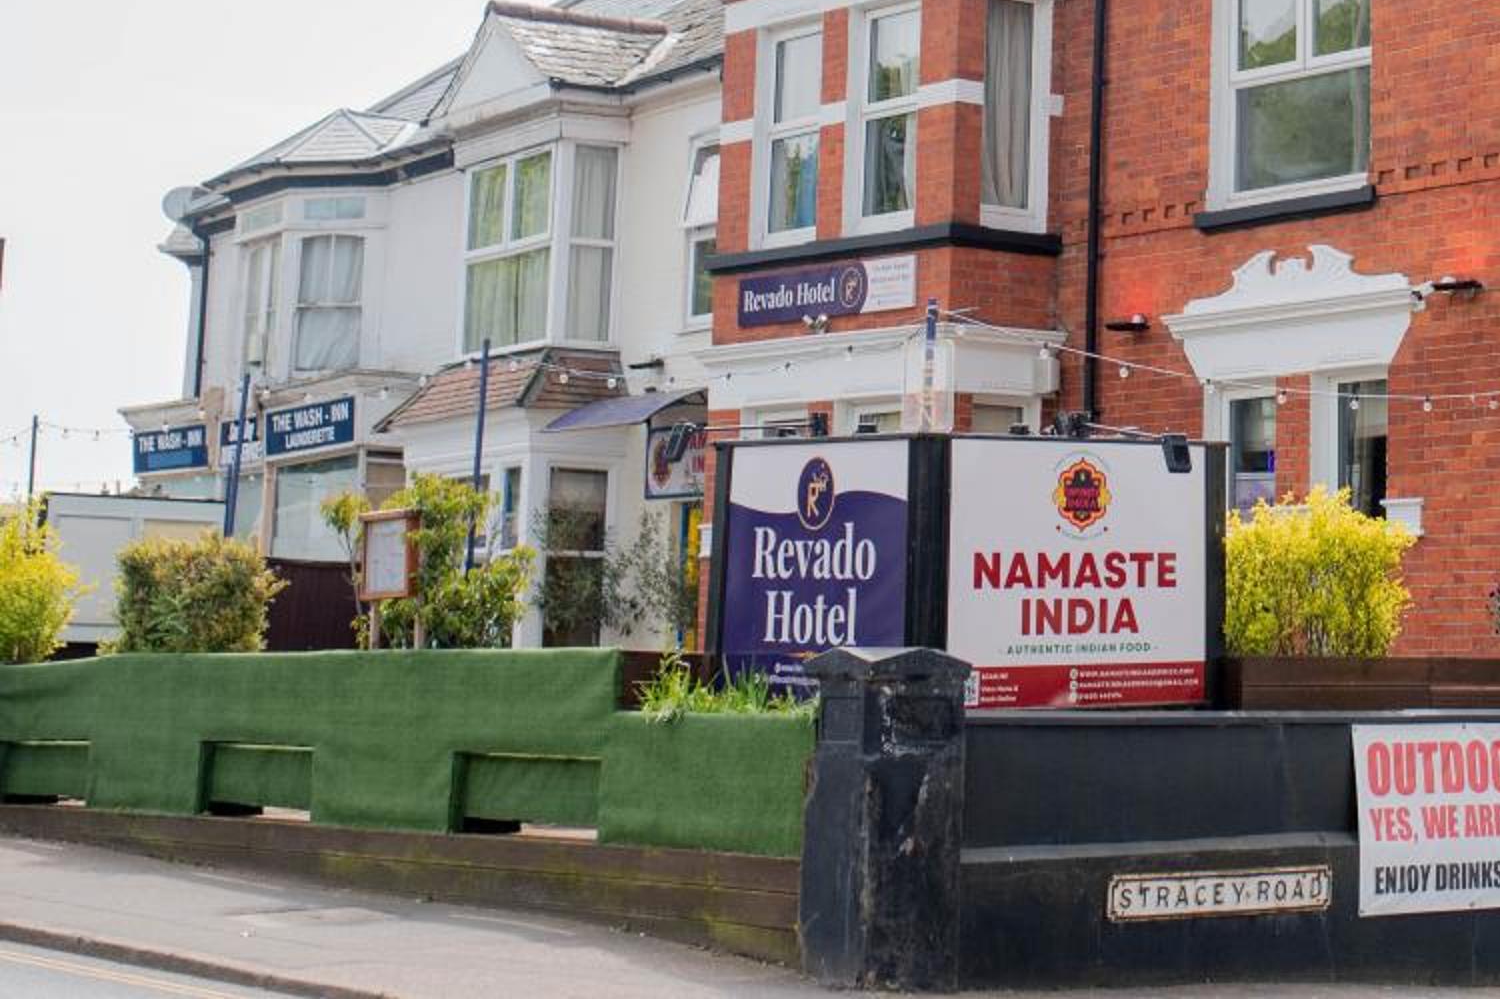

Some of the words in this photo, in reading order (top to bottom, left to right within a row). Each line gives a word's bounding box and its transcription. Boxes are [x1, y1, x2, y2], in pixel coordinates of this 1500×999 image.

[743, 284, 793, 313] Revado
[797, 277, 835, 306] Hotel
[271, 413, 291, 433] THE
[293, 407, 323, 429] WASH
[331, 402, 349, 421] INN
[138, 436, 155, 453] THE
[752, 522, 877, 580] Revado
[973, 552, 1177, 589] NAMASTE
[763, 587, 857, 646] Hotel
[1020, 599, 1139, 635] INDIA
[1007, 644, 1073, 655] AUTHENTIC
[1075, 643, 1117, 653] INDIAN
[1119, 642, 1151, 652] FOOD
[1370, 807, 1419, 843] YES,
[1421, 804, 1460, 840] WE
[1119, 882, 1246, 909] STRACEY
[1256, 875, 1323, 902] ROAD
[1374, 865, 1431, 894] ENJOY
